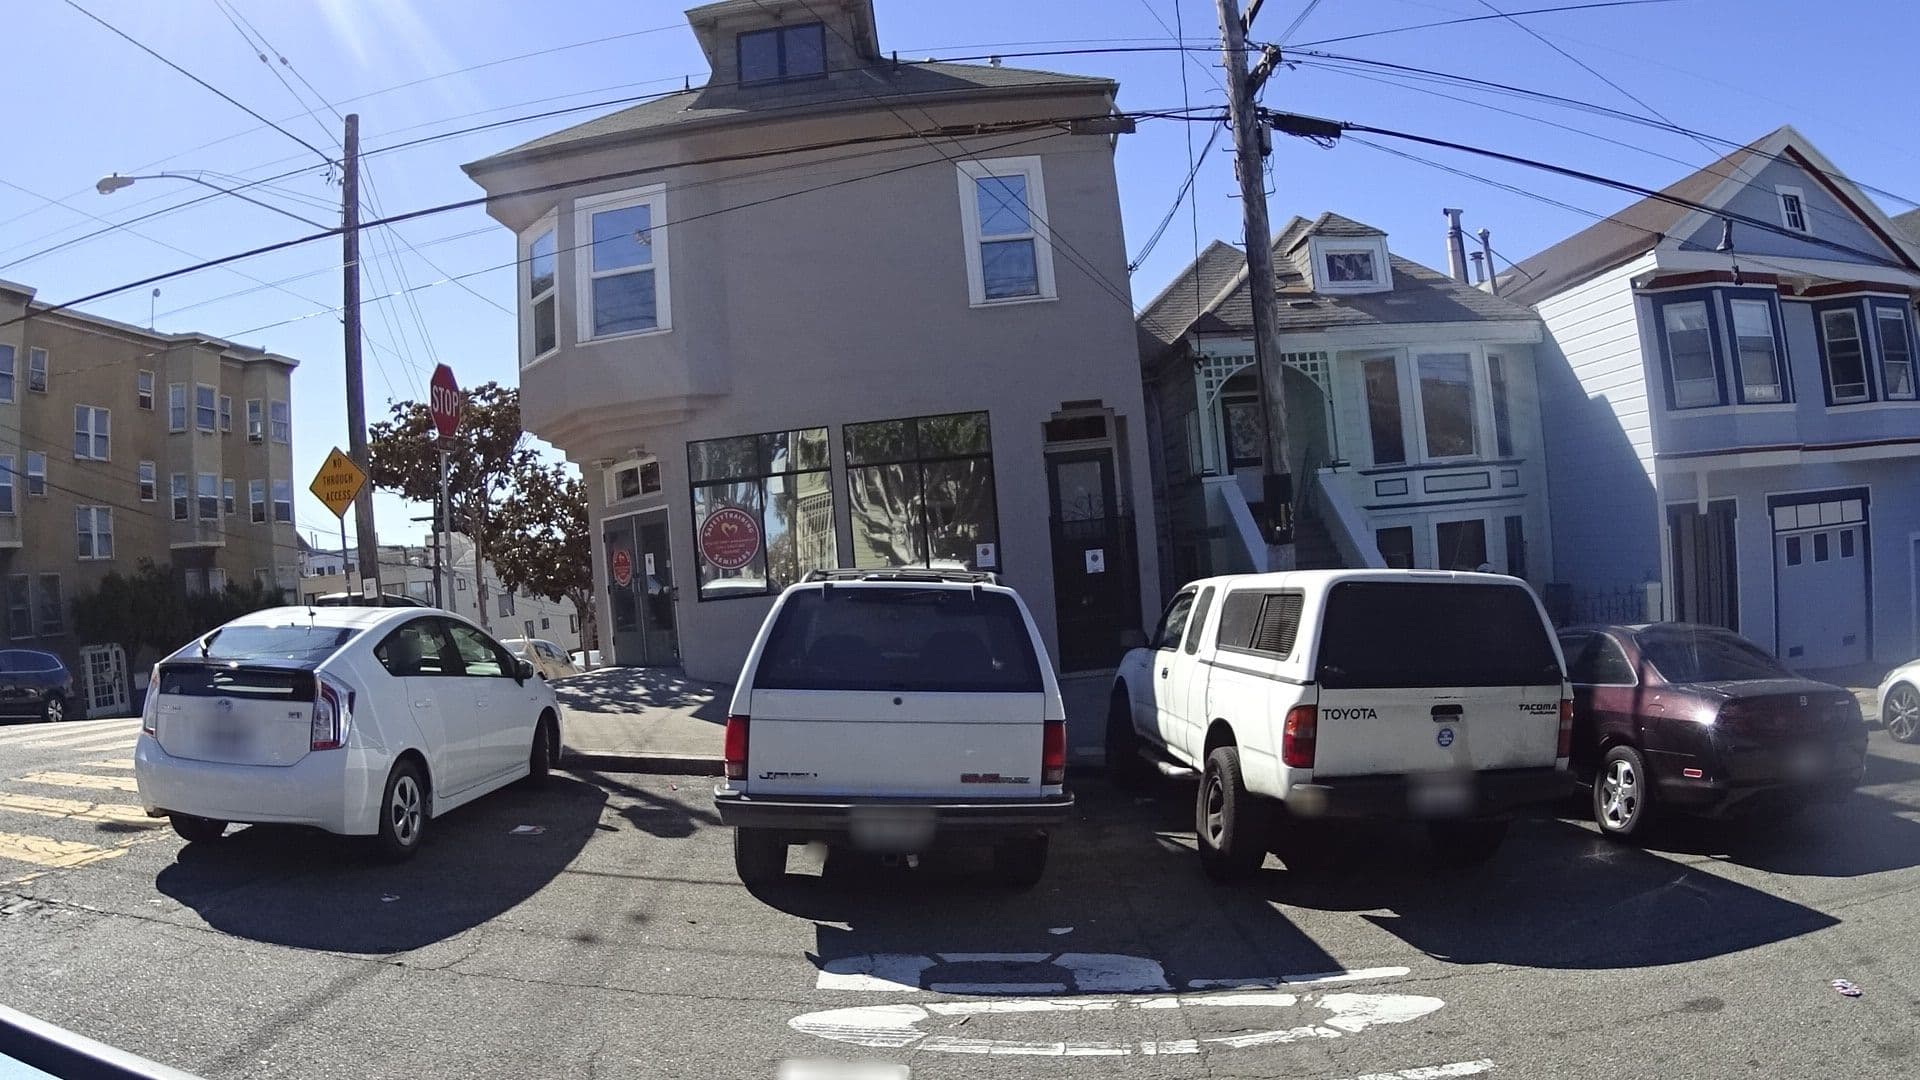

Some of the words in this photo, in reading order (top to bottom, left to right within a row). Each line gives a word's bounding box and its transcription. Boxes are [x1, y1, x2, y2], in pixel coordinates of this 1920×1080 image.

[432, 385, 459, 417] STOP
[333, 458, 342, 468] NO
[323, 473, 353, 486] THROUGH
[326, 489, 351, 502] ACCESS
[1518, 703, 1557, 711] TACOMA
[1321, 708, 1378, 720] TOYOTA
